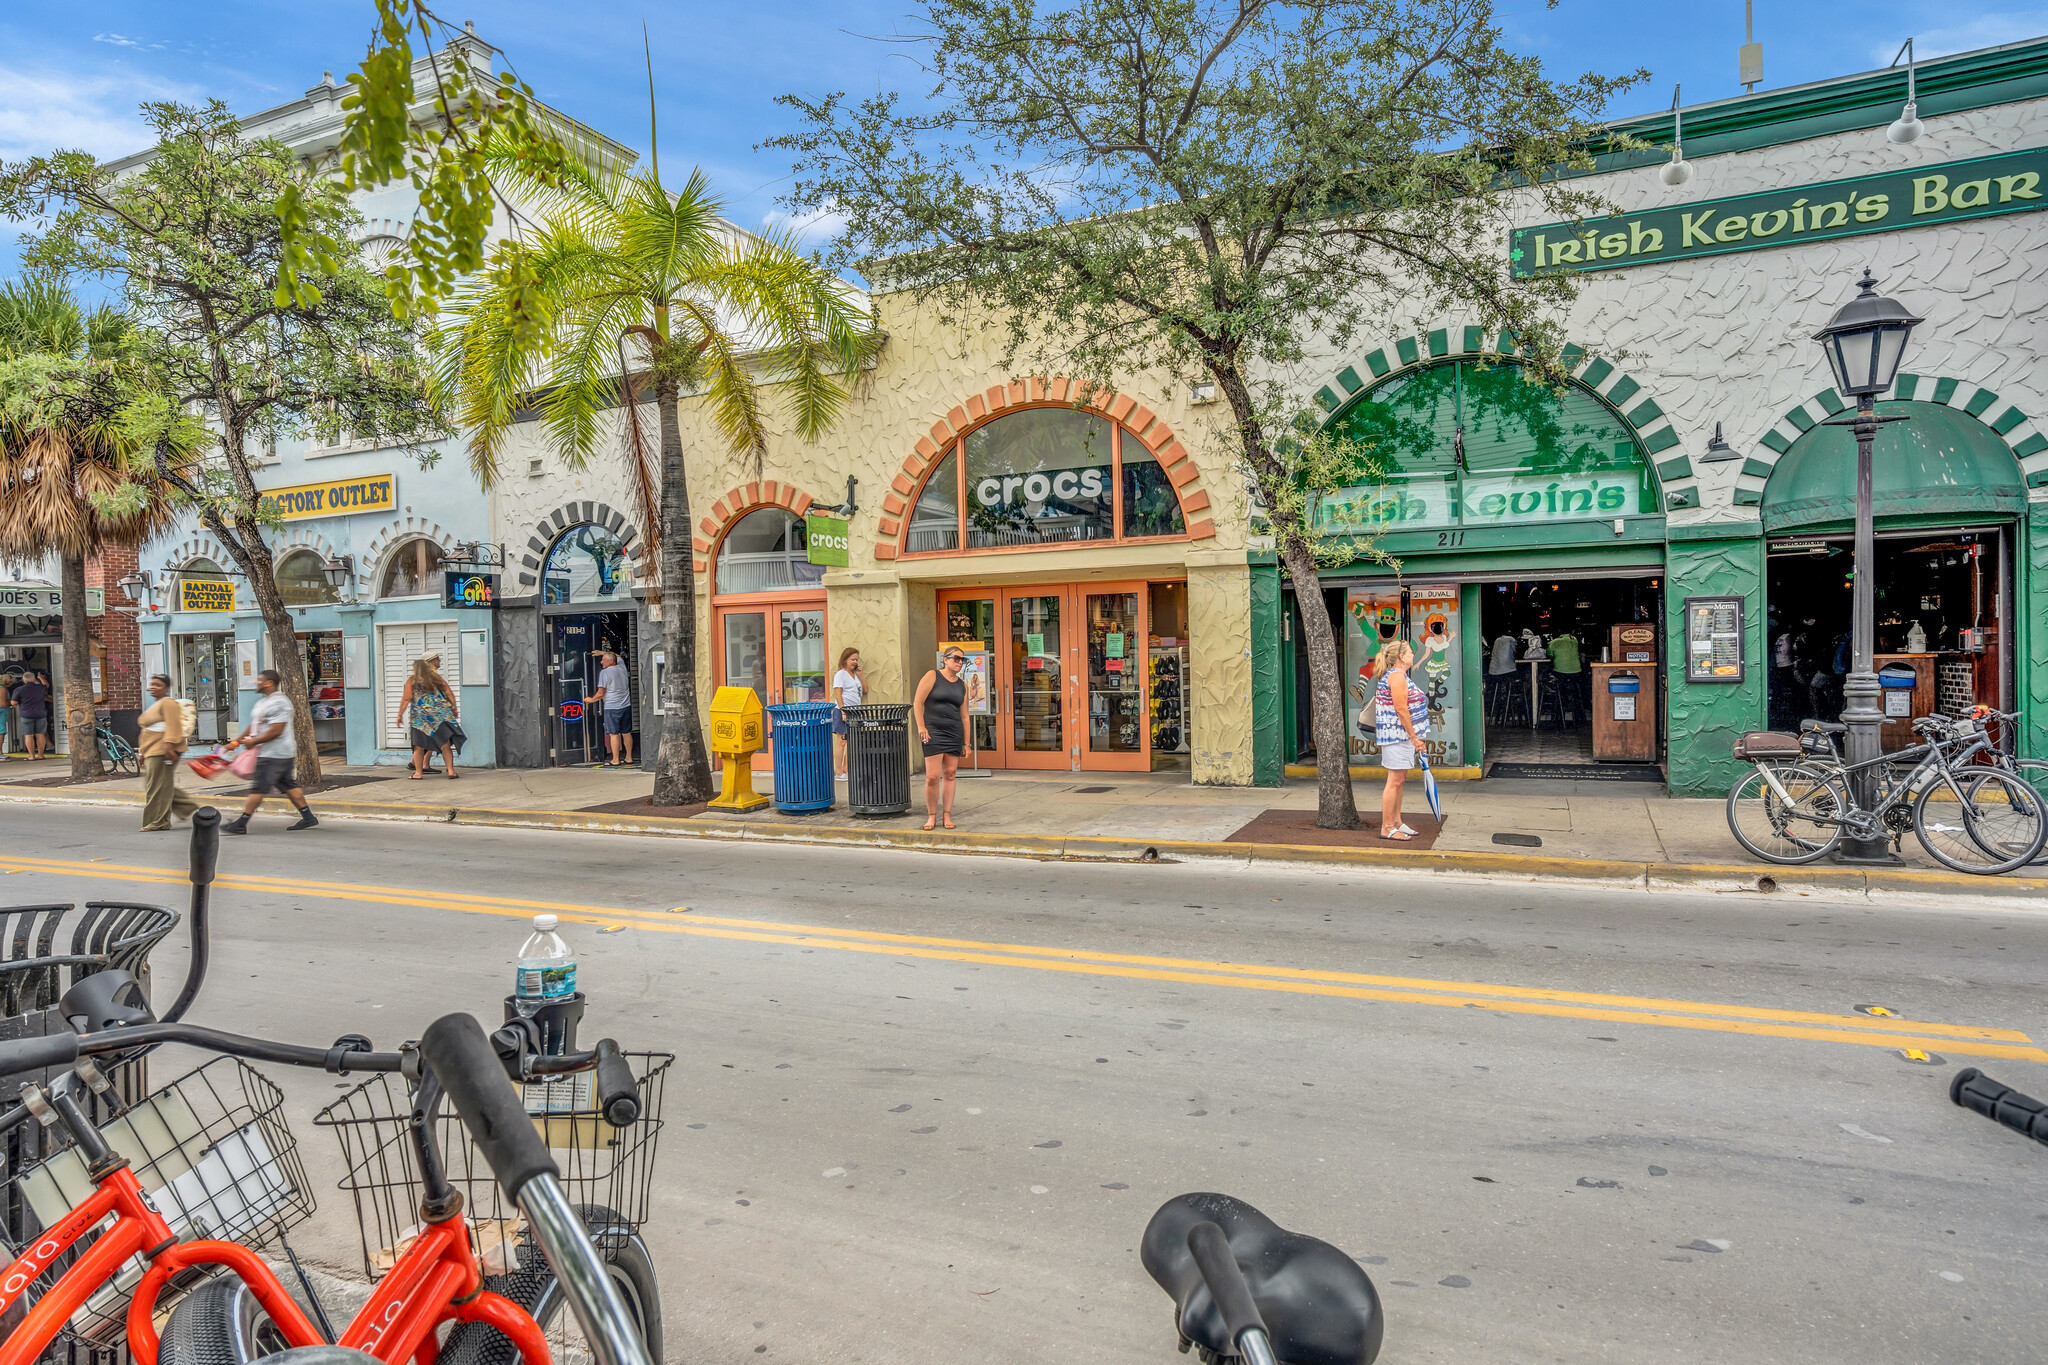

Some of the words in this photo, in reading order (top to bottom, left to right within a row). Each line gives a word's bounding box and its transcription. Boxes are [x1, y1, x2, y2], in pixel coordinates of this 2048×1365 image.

[1534, 220, 1664, 268] Irish
[1681, 191, 1890, 248] Kevin's
[1912, 171, 2043, 216] Bar
[977, 468, 1103, 506] crocs
[260, 489, 325, 514] FACTORY
[328, 481, 390, 508] OUTLET
[1449, 479, 1626, 518] Kevin's
[810, 532, 848, 550] crocs
[1437, 531, 1464, 547] 211
[184, 591, 233, 601] FACTORY
[185, 582, 231, 592] SANDAL
[454, 577, 493, 606] Light
[1427, 590, 1451, 598] DUVAL
[187, 600, 231, 610] OUTLET
[560, 704, 583, 717] OPEN
[62, 1211, 94, 1241] cruz
